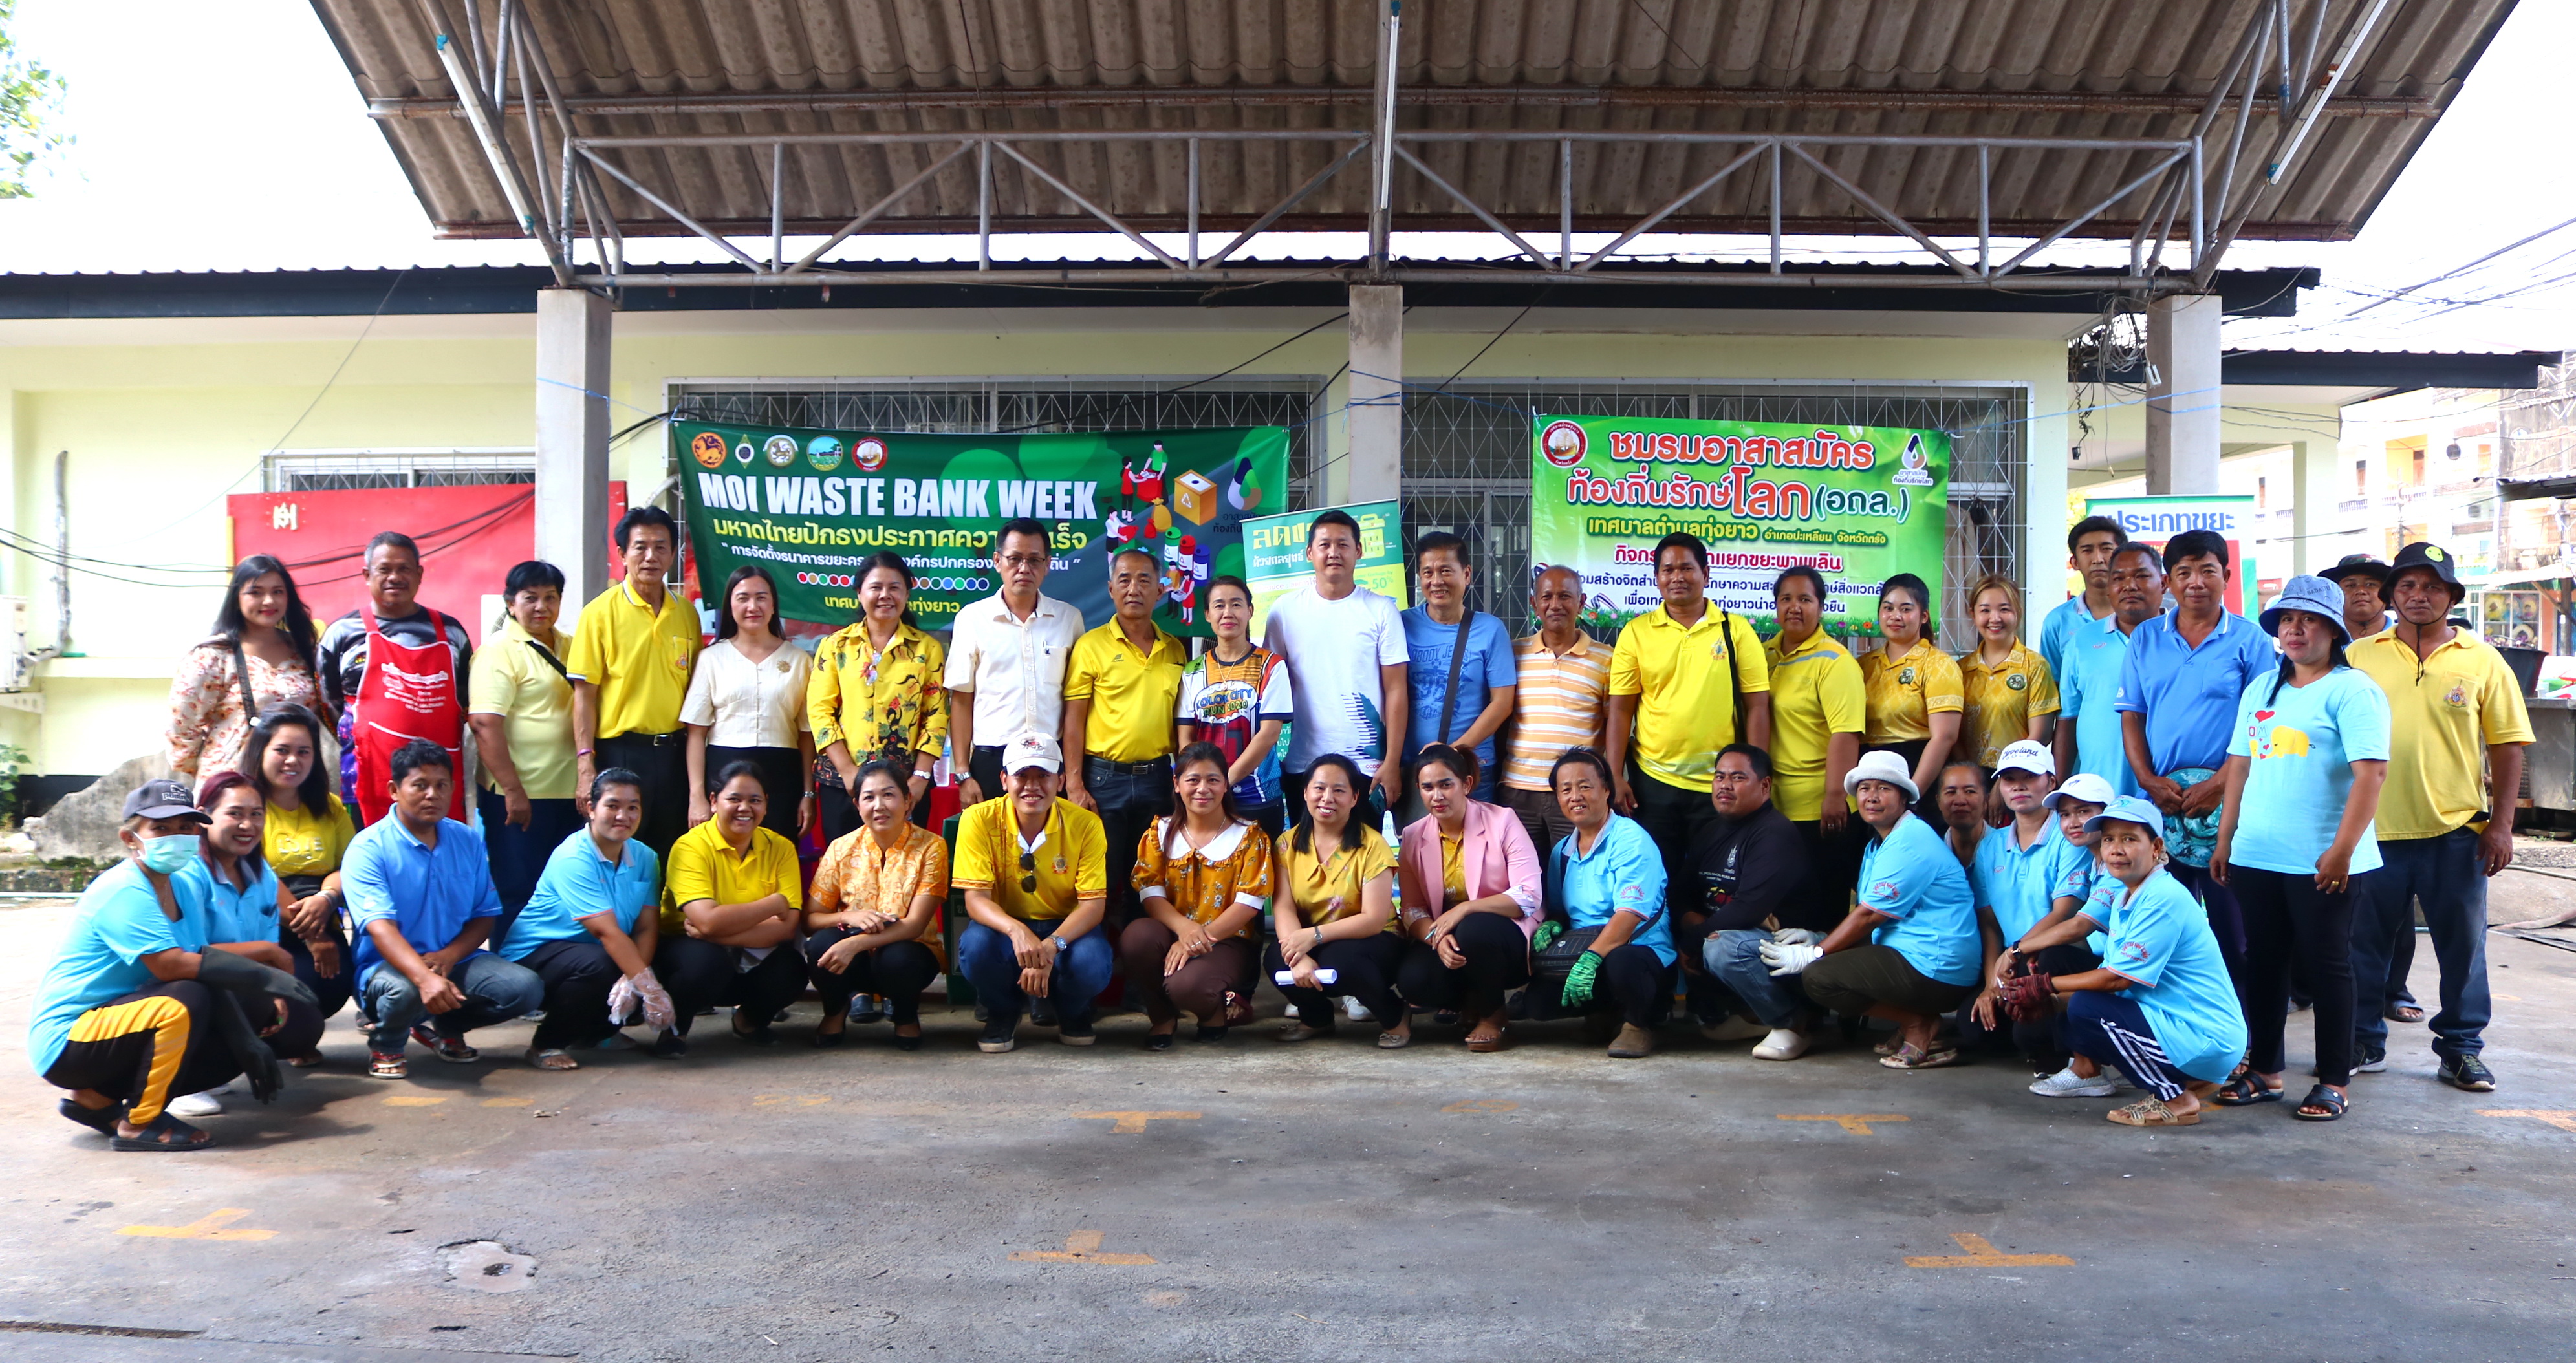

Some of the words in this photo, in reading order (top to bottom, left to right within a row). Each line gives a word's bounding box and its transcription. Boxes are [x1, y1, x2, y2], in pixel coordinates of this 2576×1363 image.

[1609, 429, 1874, 471] ชมรมอาสาสมัคร
[698, 472, 758, 513] MOI
[765, 476, 885, 516] WASTE
[894, 478, 990, 517] BANK
[998, 480, 1098, 519] WEEK
[1764, 528, 1832, 542] อำเภอปะเหลียน
[1230, 688, 1253, 700] CITY
[1203, 707, 1225, 716] RUN
[1227, 700, 1248, 711] 2020
